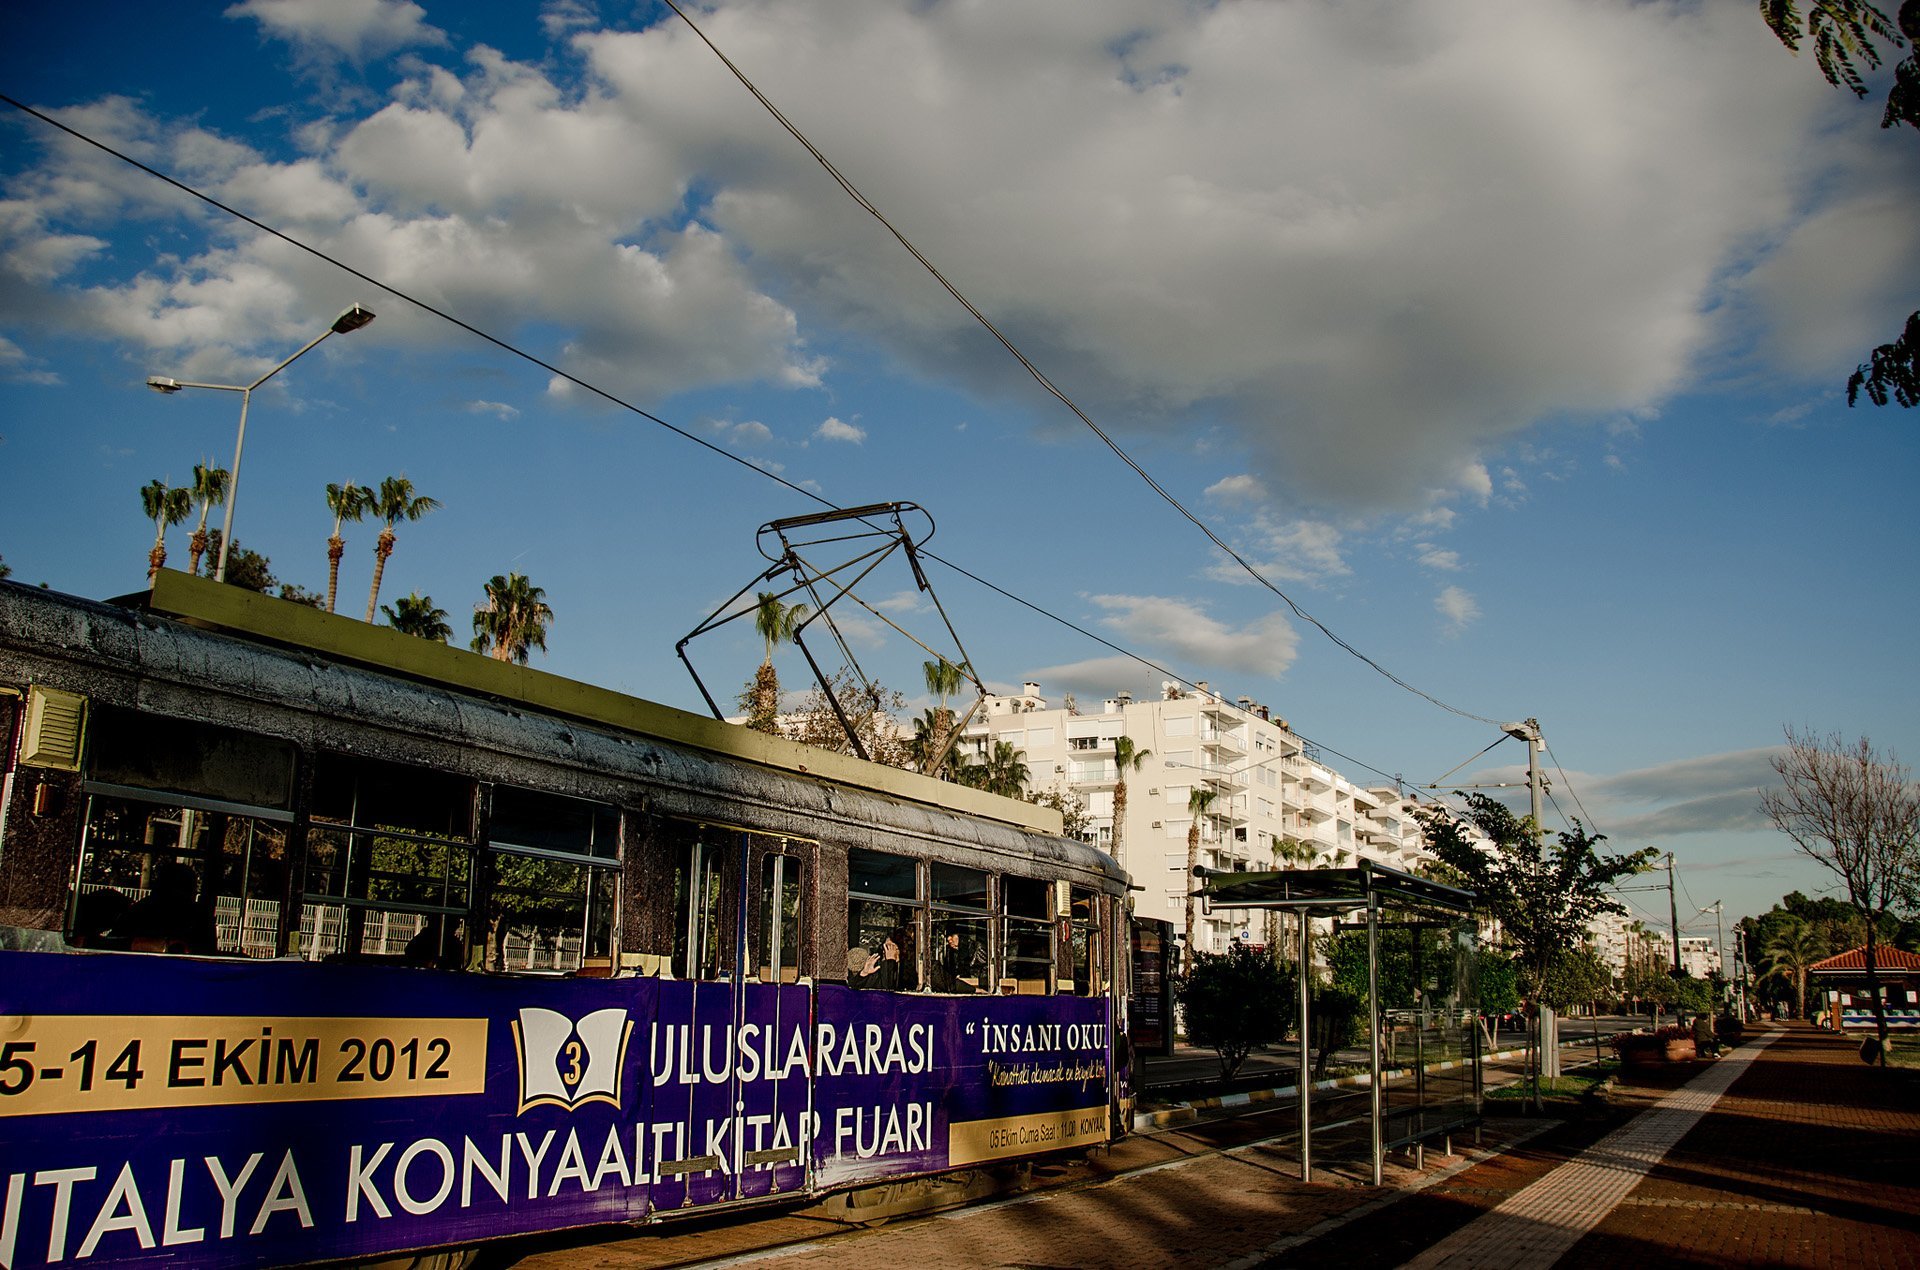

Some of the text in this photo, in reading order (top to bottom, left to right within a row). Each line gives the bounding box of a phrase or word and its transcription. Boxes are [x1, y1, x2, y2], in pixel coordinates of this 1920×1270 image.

[167, 1026, 319, 1088] EKİM
[337, 1037, 452, 1082] 2012
[650, 1023, 934, 1087] ULUSLARARASI
[345, 1121, 684, 1223] KONYAALTI
[704, 1101, 821, 1177] KİTAP
[835, 1101, 933, 1161] FUARI
